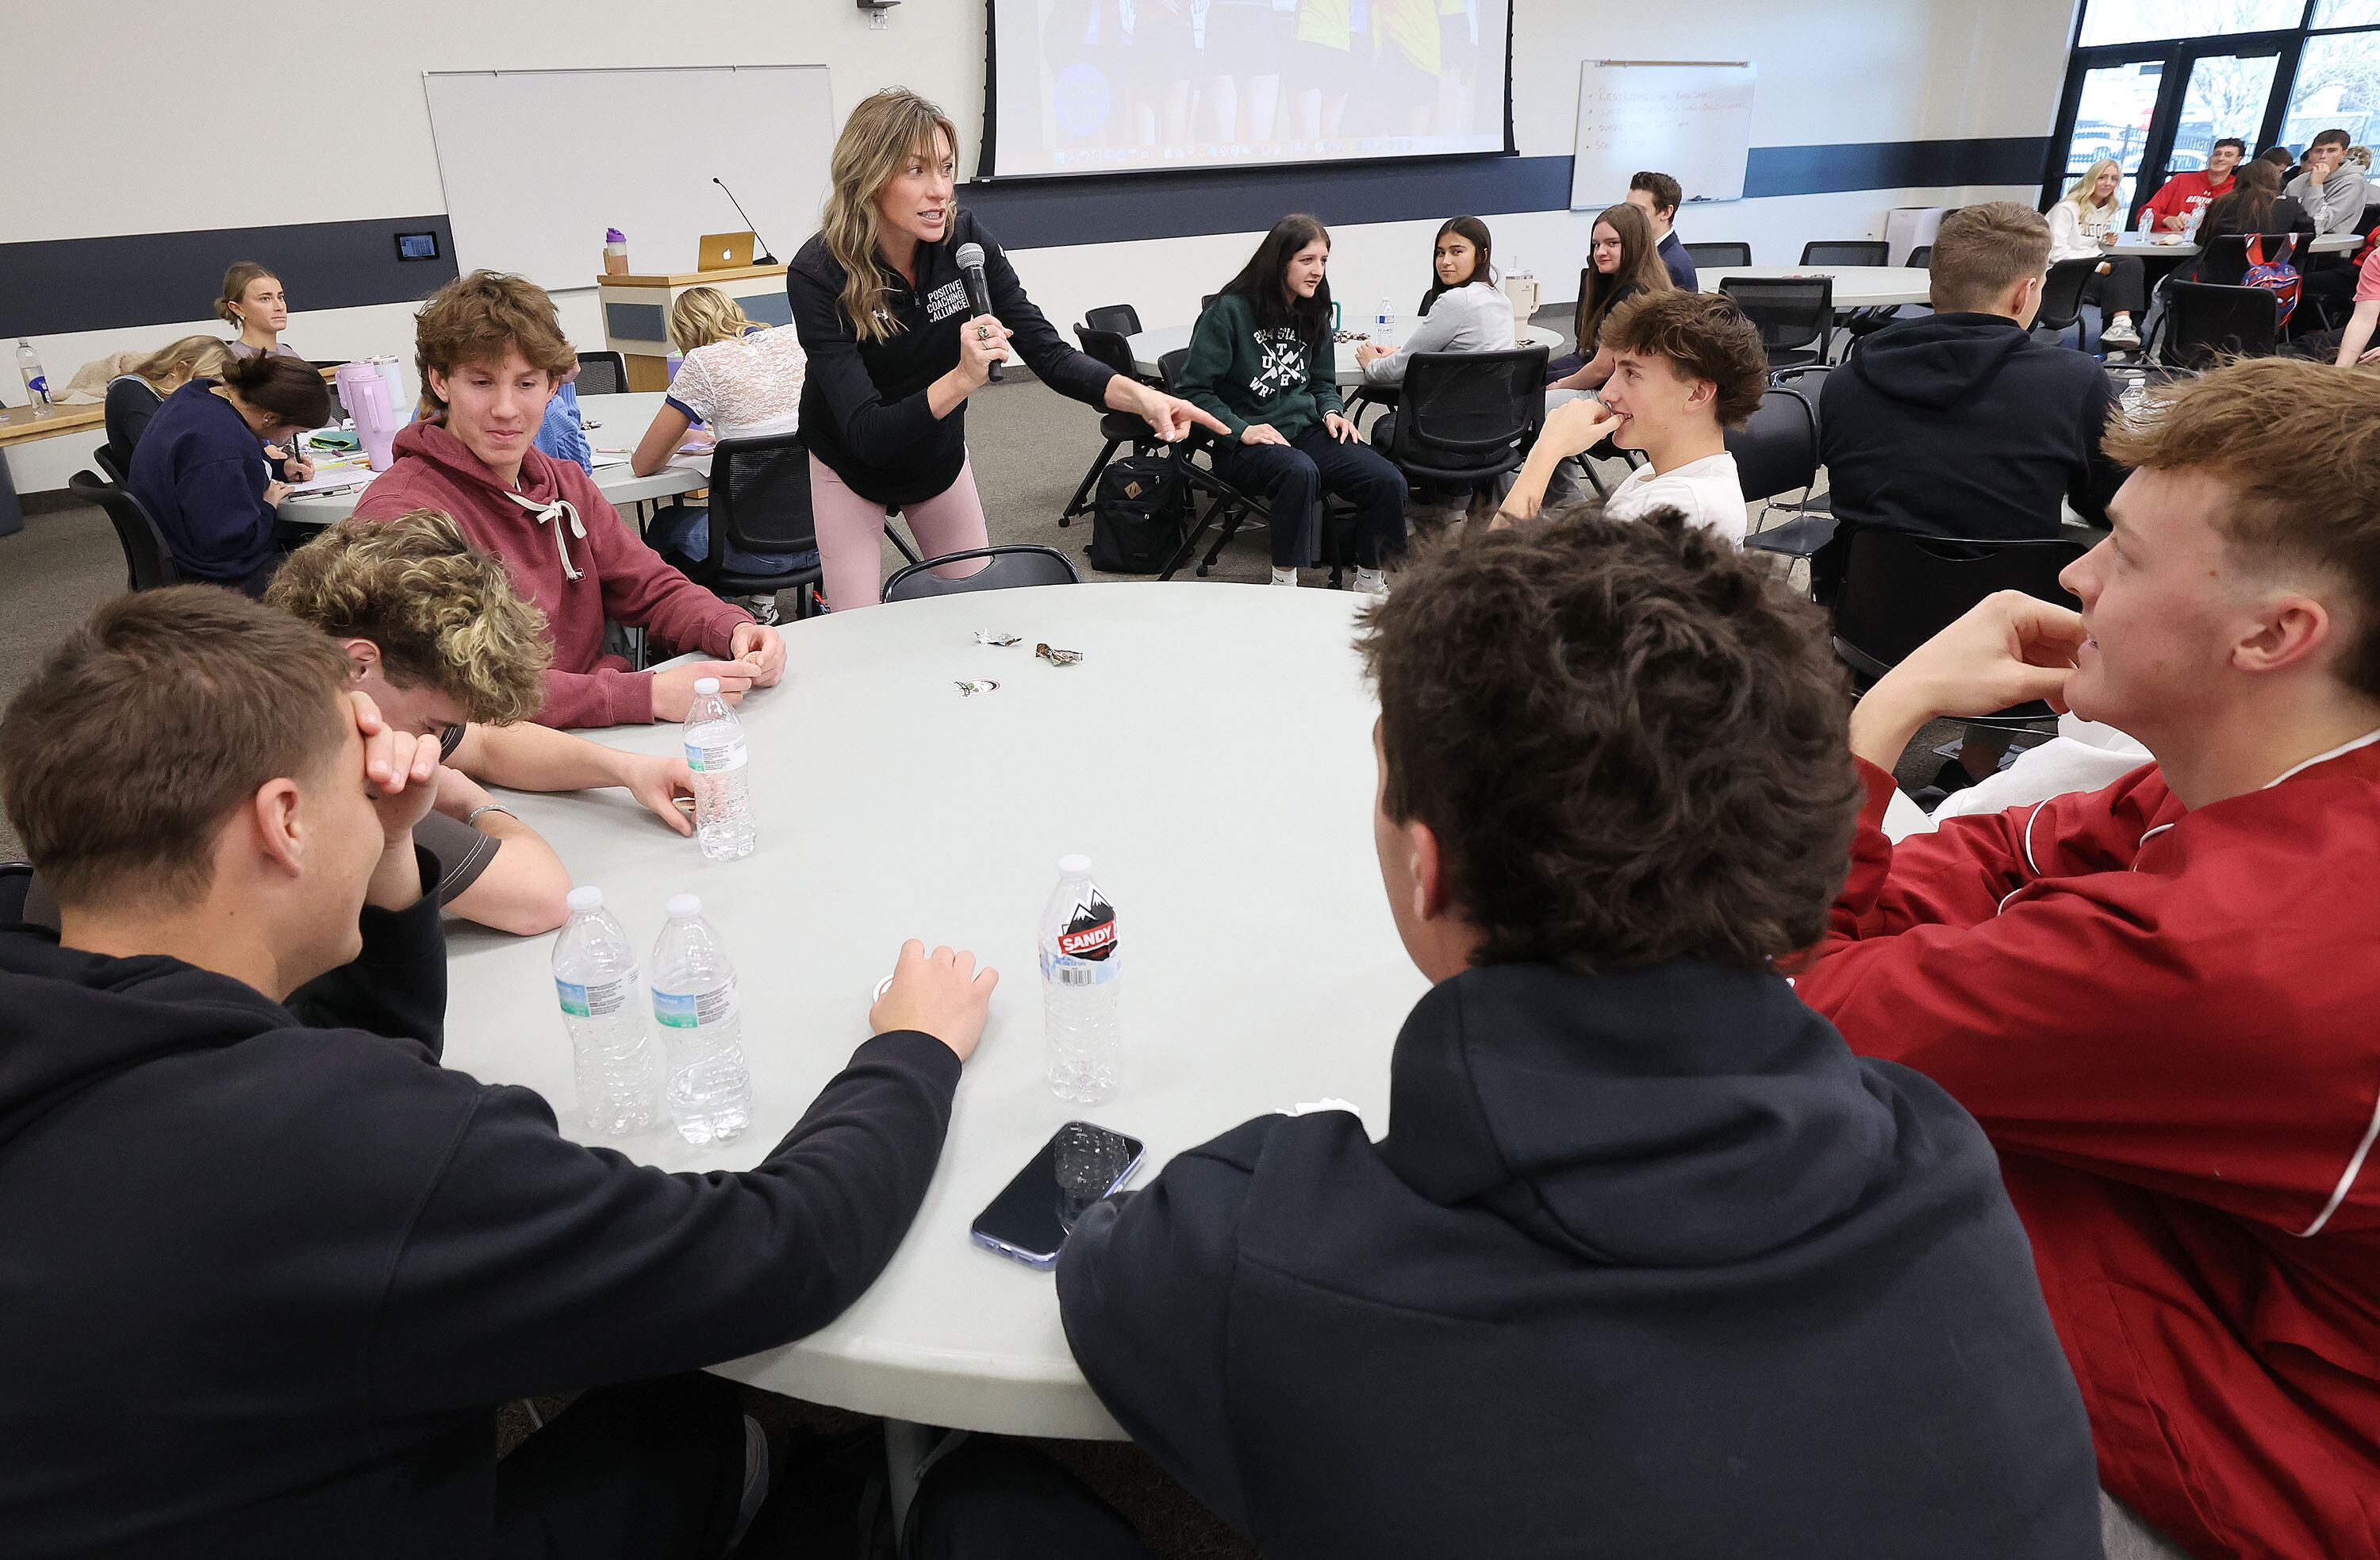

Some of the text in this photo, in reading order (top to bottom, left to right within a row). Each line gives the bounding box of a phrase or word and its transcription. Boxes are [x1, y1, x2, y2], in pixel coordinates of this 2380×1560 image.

[926, 289, 965, 313] COACHING
[927, 279, 962, 303] POSITIVE
[933, 298, 969, 322] ALLIANCE
[1062, 925, 1111, 951] SANDY
